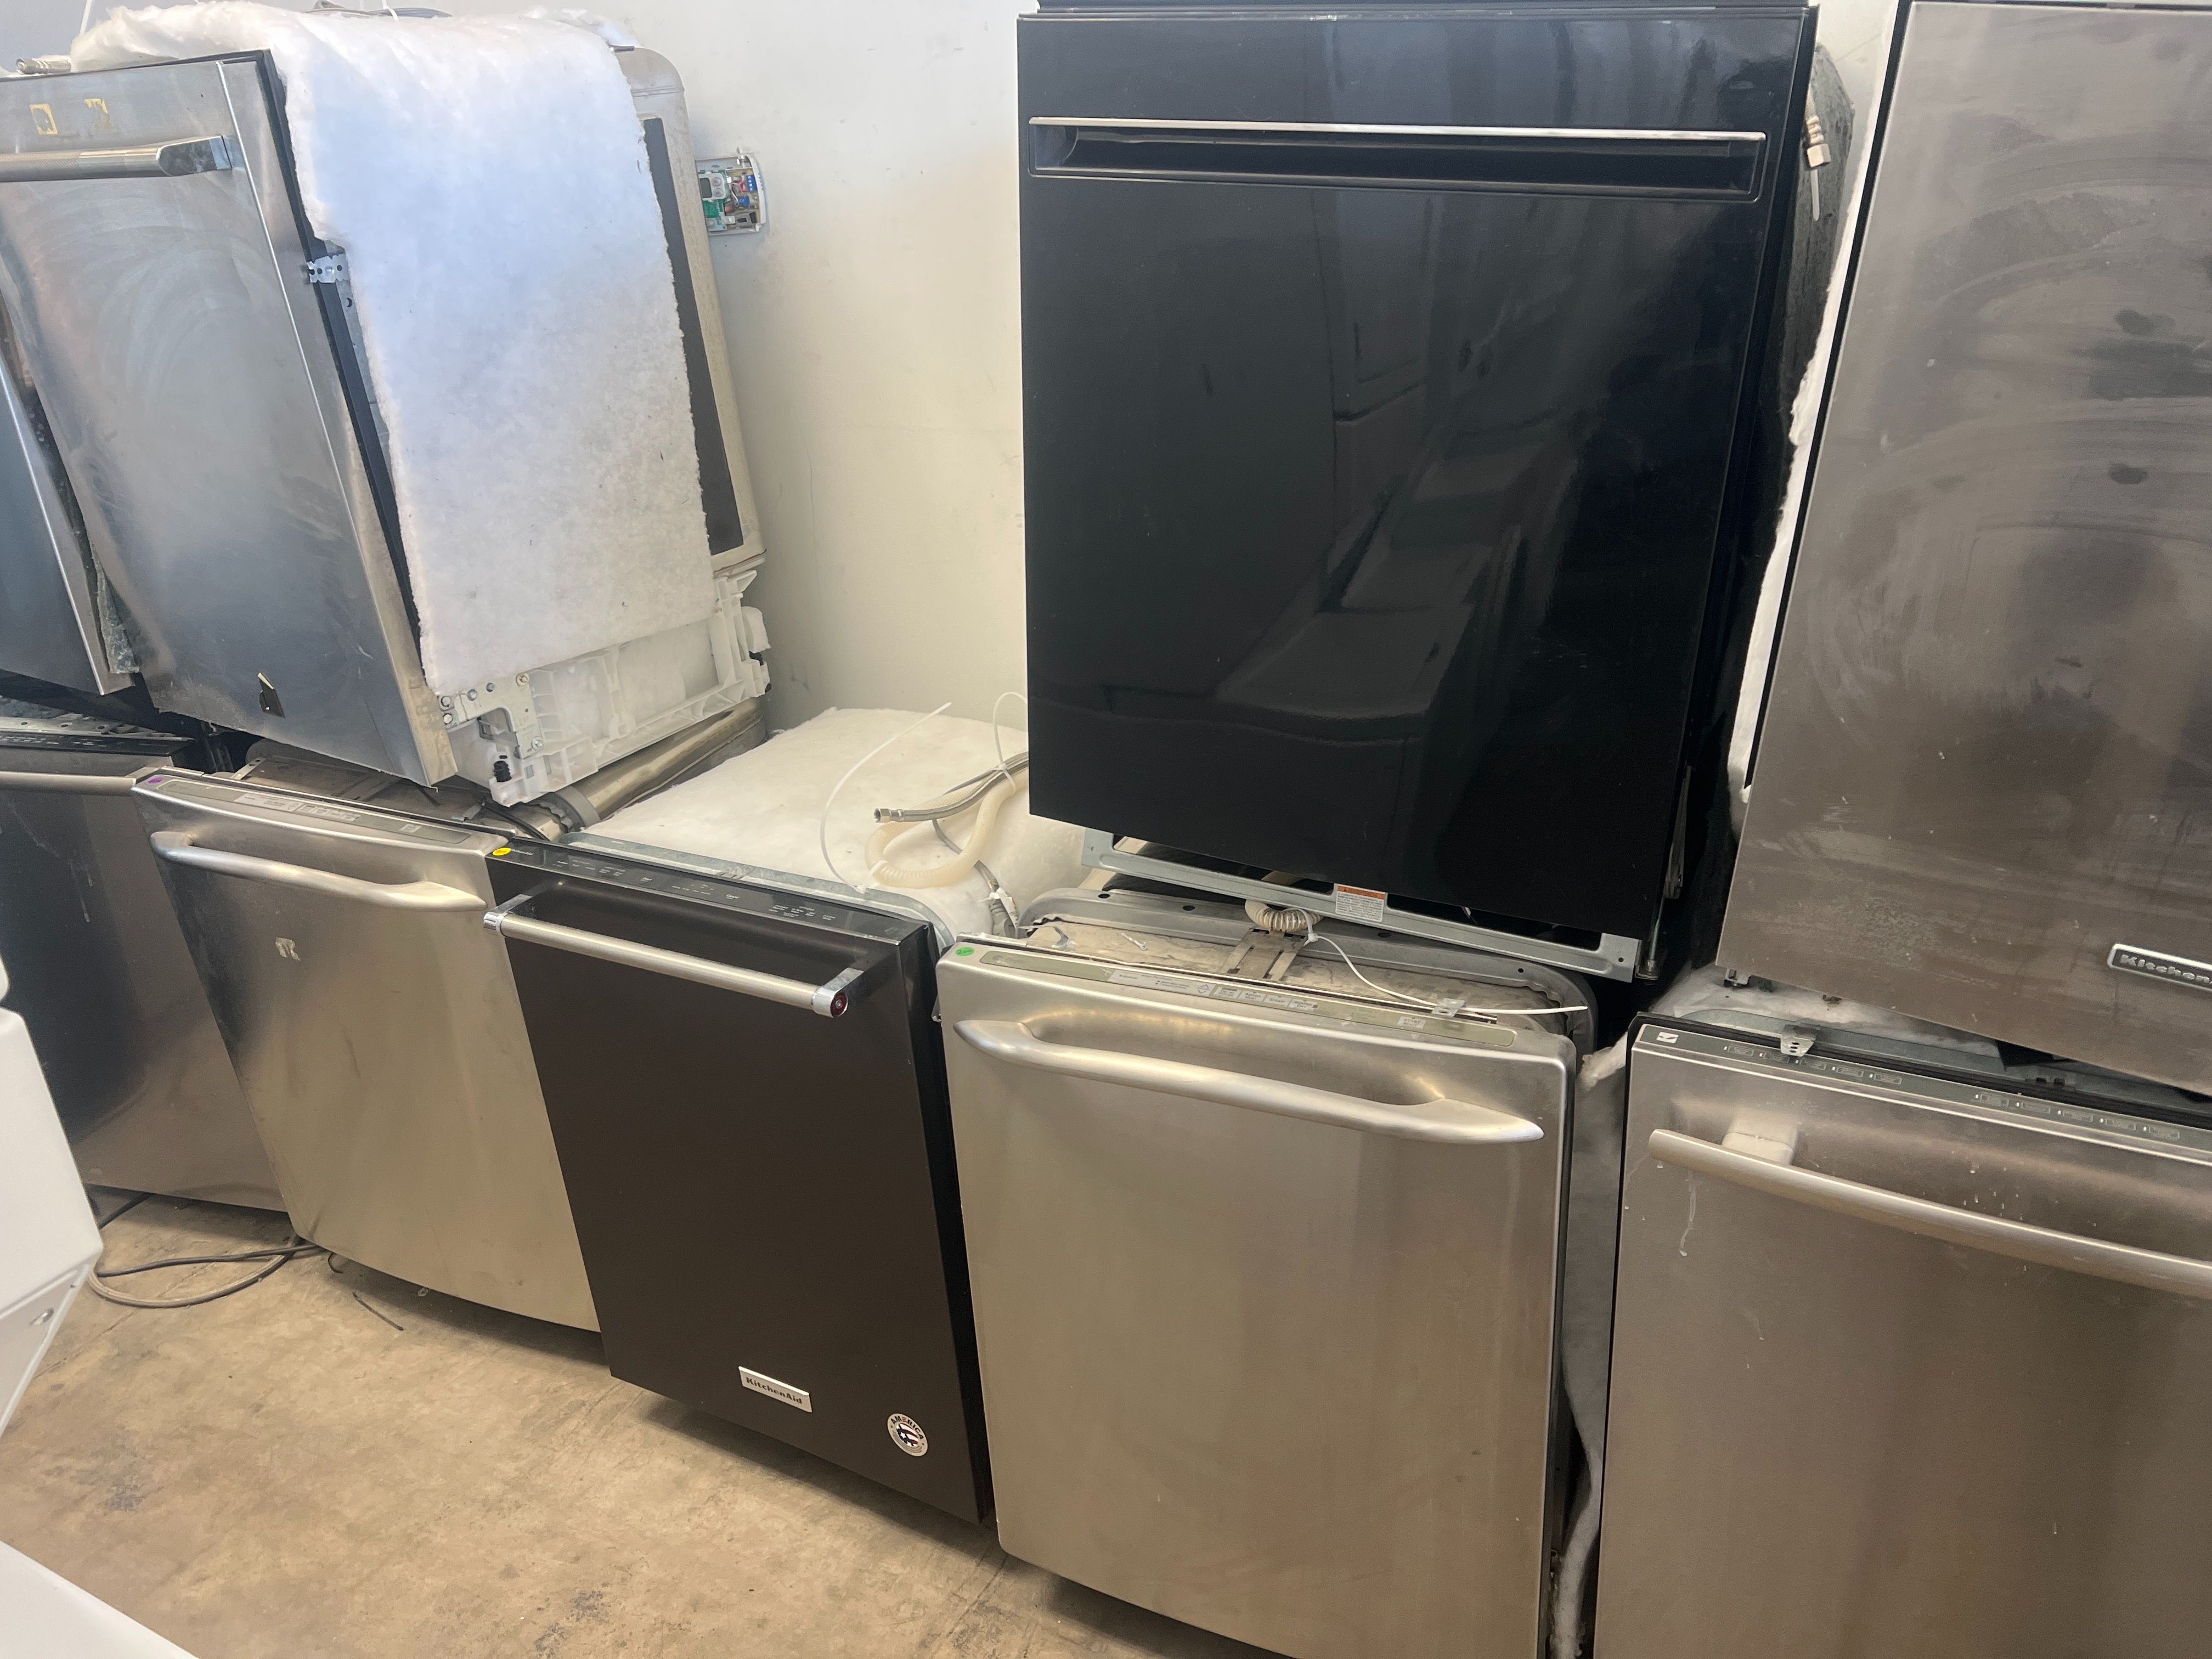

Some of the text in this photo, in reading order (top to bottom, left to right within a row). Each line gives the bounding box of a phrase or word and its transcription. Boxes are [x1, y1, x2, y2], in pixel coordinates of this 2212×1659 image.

[2120, 954, 2212, 984] Kitchen
[746, 1377, 803, 1404] KitchenAid
[890, 1415, 924, 1440] AMERICA
